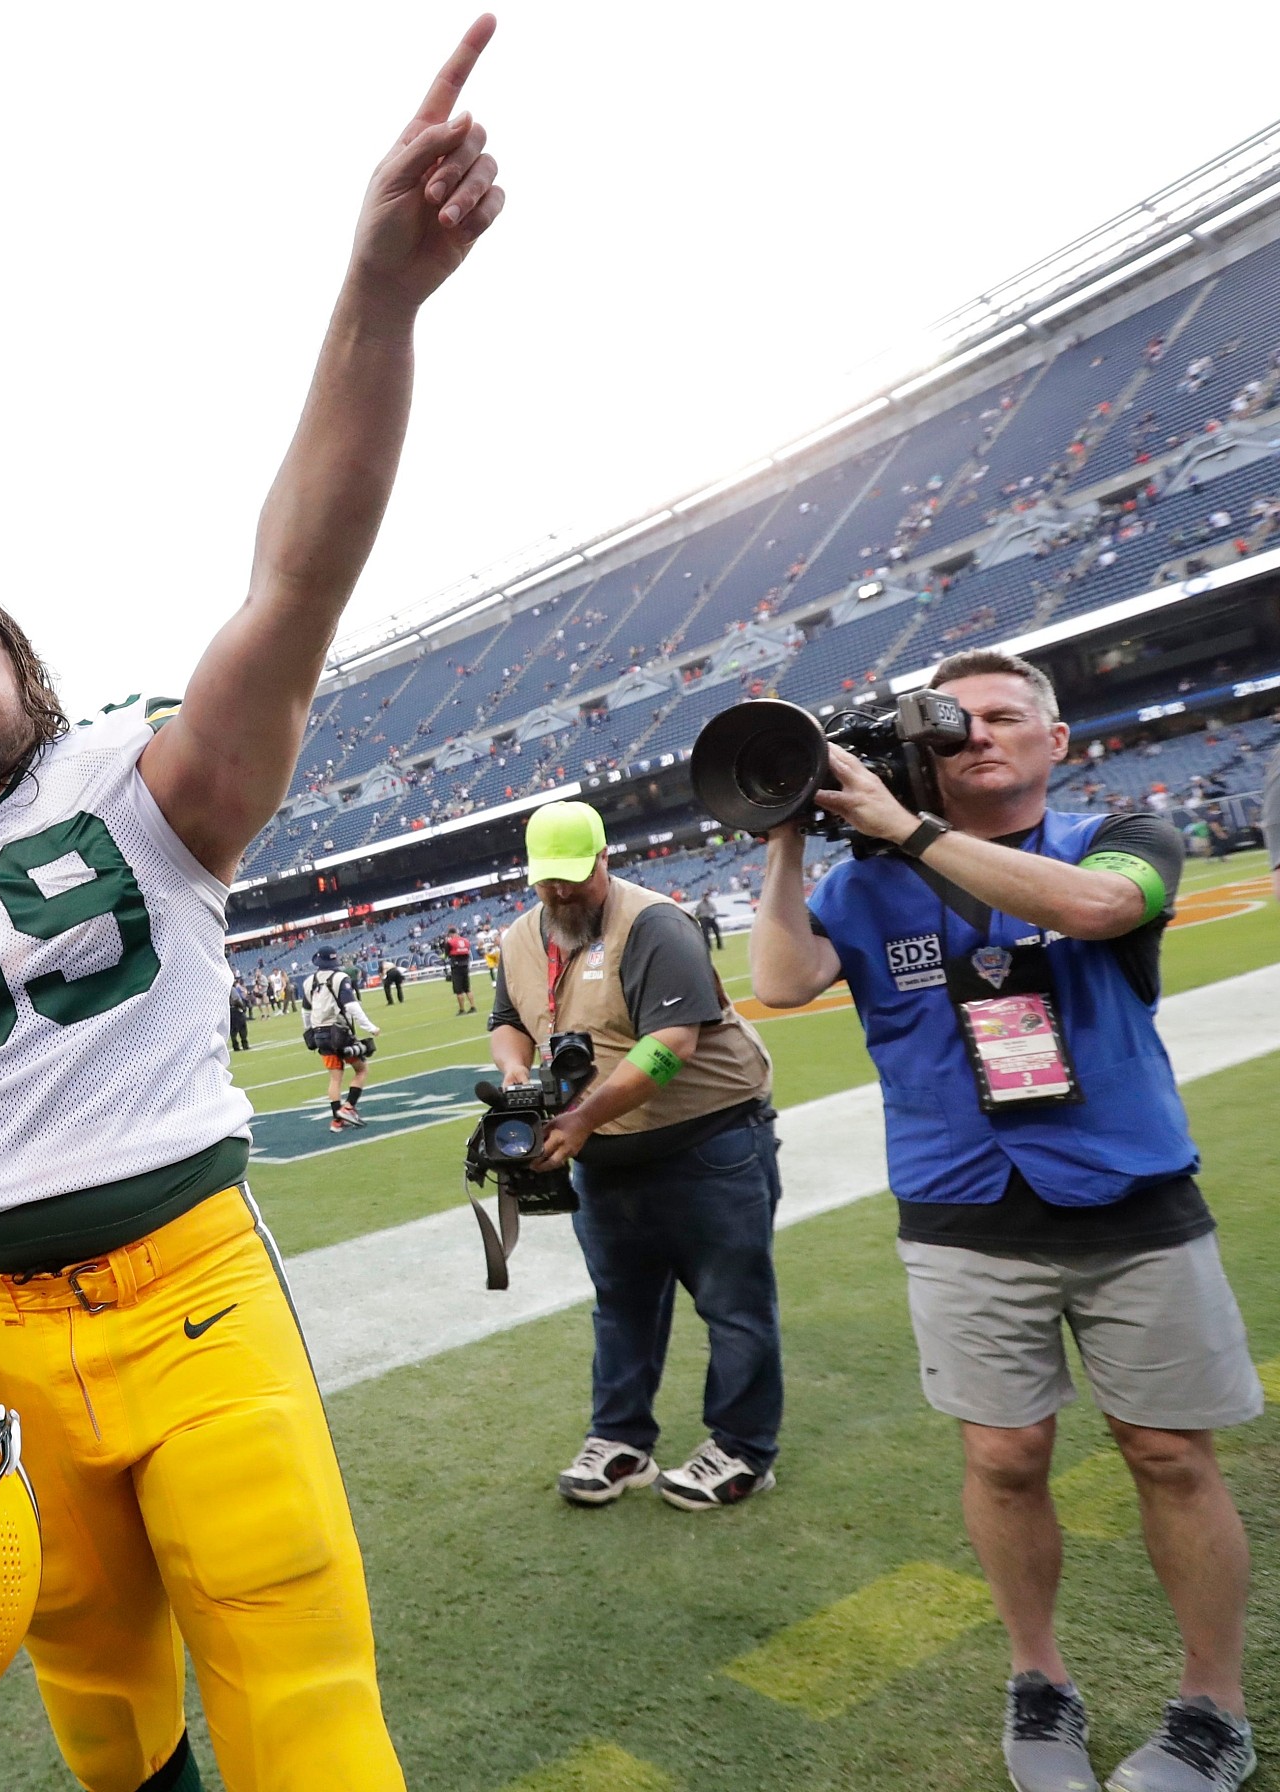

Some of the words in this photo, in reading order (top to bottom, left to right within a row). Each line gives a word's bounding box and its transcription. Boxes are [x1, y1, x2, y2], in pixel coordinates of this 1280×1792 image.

[938, 703, 959, 722] SDS
[889, 940, 939, 968] SDS
[1022, 1072, 1033, 1086] 3
